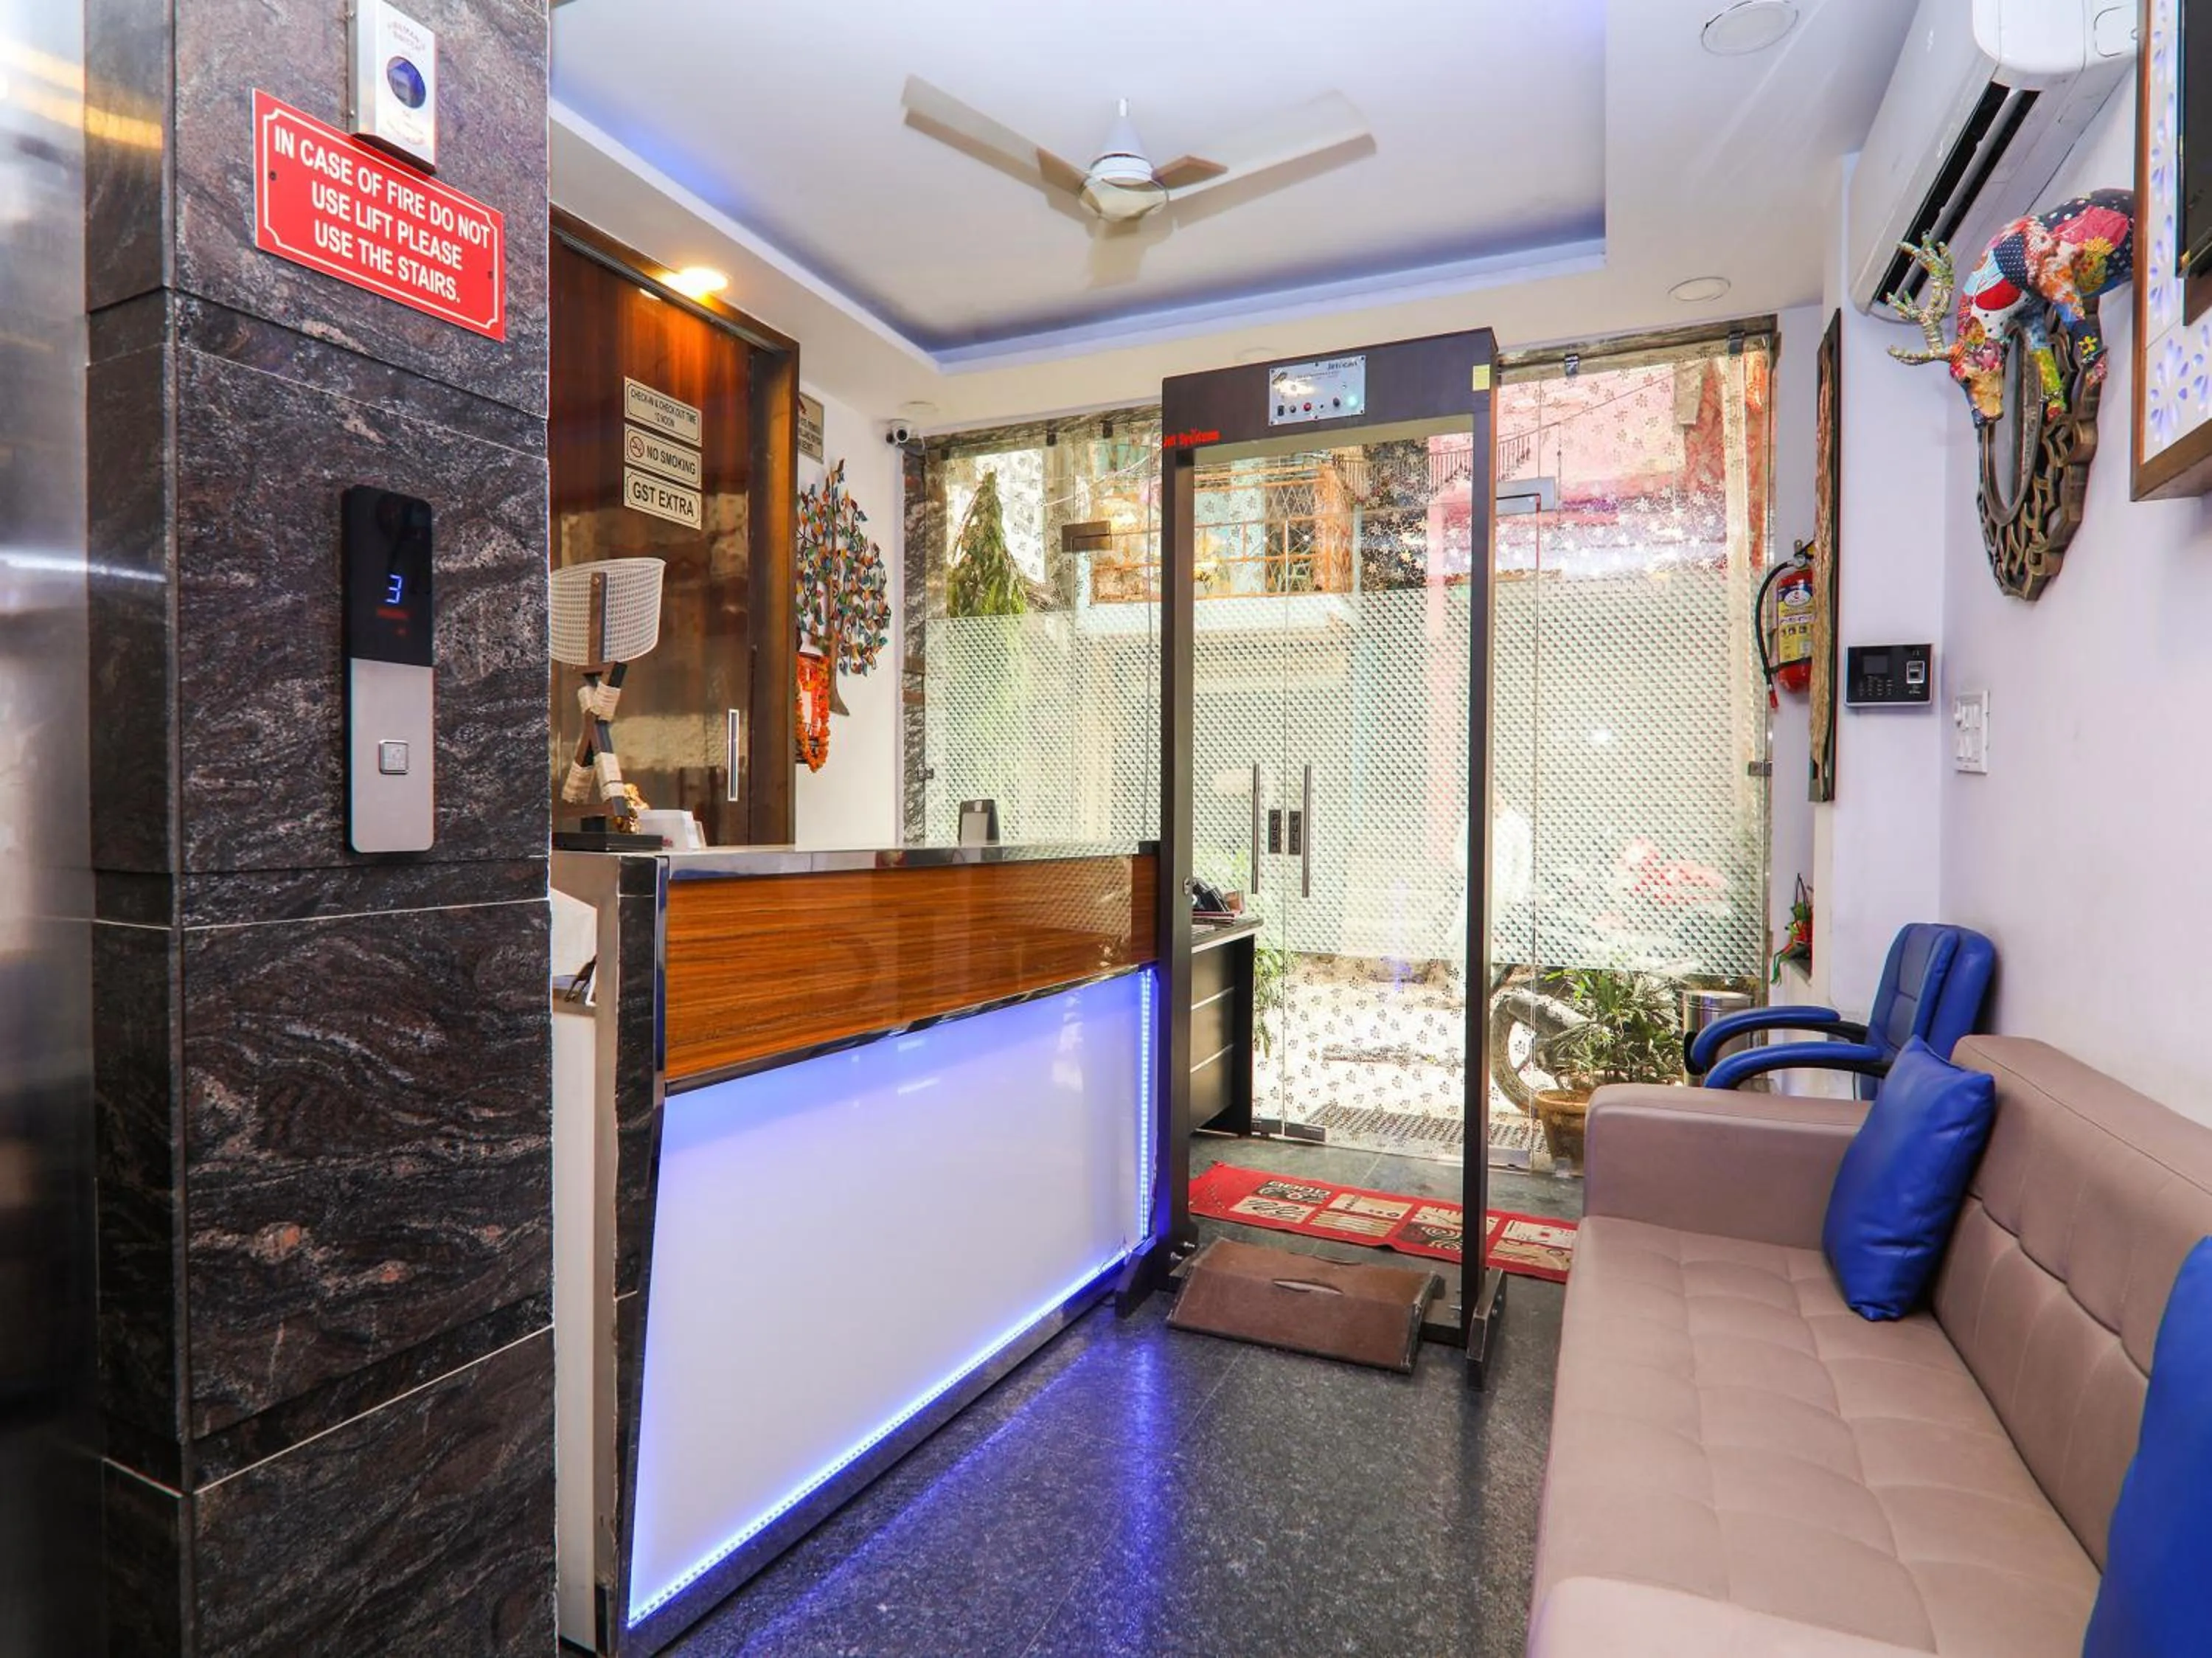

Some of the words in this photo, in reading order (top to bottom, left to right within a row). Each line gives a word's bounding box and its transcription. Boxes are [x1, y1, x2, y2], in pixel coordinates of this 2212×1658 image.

[274, 125, 294, 159] IN
[300, 139, 353, 186] CASE
[358, 170, 382, 198] OF
[387, 180, 425, 219] FIRE
[430, 201, 453, 232] DO
[457, 214, 490, 249] NOT
[311, 181, 350, 222] USE
[356, 199, 392, 238] LIFT
[397, 219, 463, 271] PLEASE
[315, 219, 353, 259] USE
[358, 235, 392, 274] THE
[397, 255, 461, 303] STAIRS.
[647, 445, 659, 461] NO
[661, 448, 696, 476] SMOKING
[633, 482, 655, 503] GST
[658, 490, 695, 517] EXTRA
[384, 574, 402, 603] 3
